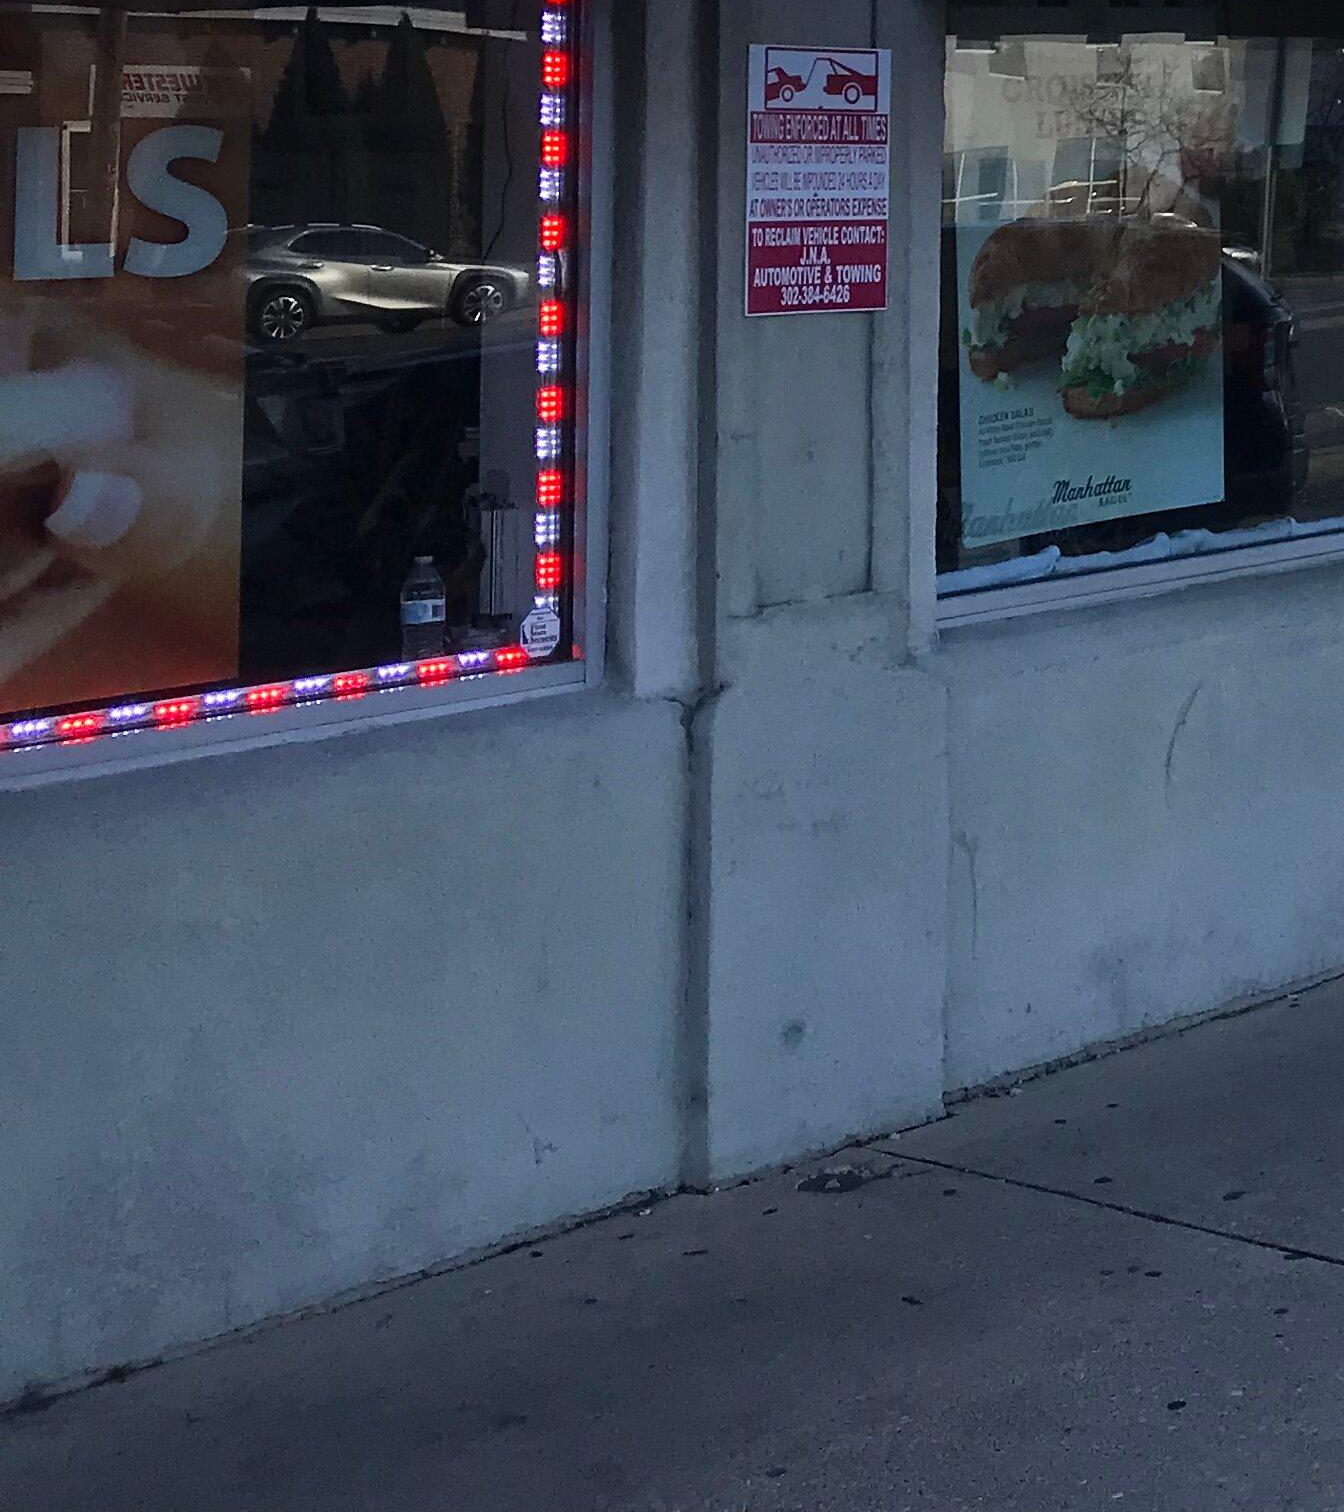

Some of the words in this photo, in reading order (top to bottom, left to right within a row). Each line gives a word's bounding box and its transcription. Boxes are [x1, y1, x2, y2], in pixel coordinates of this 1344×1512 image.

[752, 114, 784, 139] TOWING
[786, 115, 829, 140] ENFORCED
[830, 116, 842, 140] AT
[843, 116, 859, 140] ALL
[861, 117, 887, 141] TIMES
[852, 198, 887, 215] EXPENSE
[752, 228, 763, 246] TO
[765, 227, 800, 246] RECLAIM
[803, 226, 839, 245] VEHICLE
[841, 225, 885, 244] CONTACT:
[800, 246, 831, 265] J.N.A.
[753, 266, 821, 287] AUTOMOTIVE
[824, 266, 832, 283] &
[836, 264, 881, 283] TOWING
[781, 285, 850, 305] 302-384-6426
[1052, 475, 1131, 503] Manhattan
